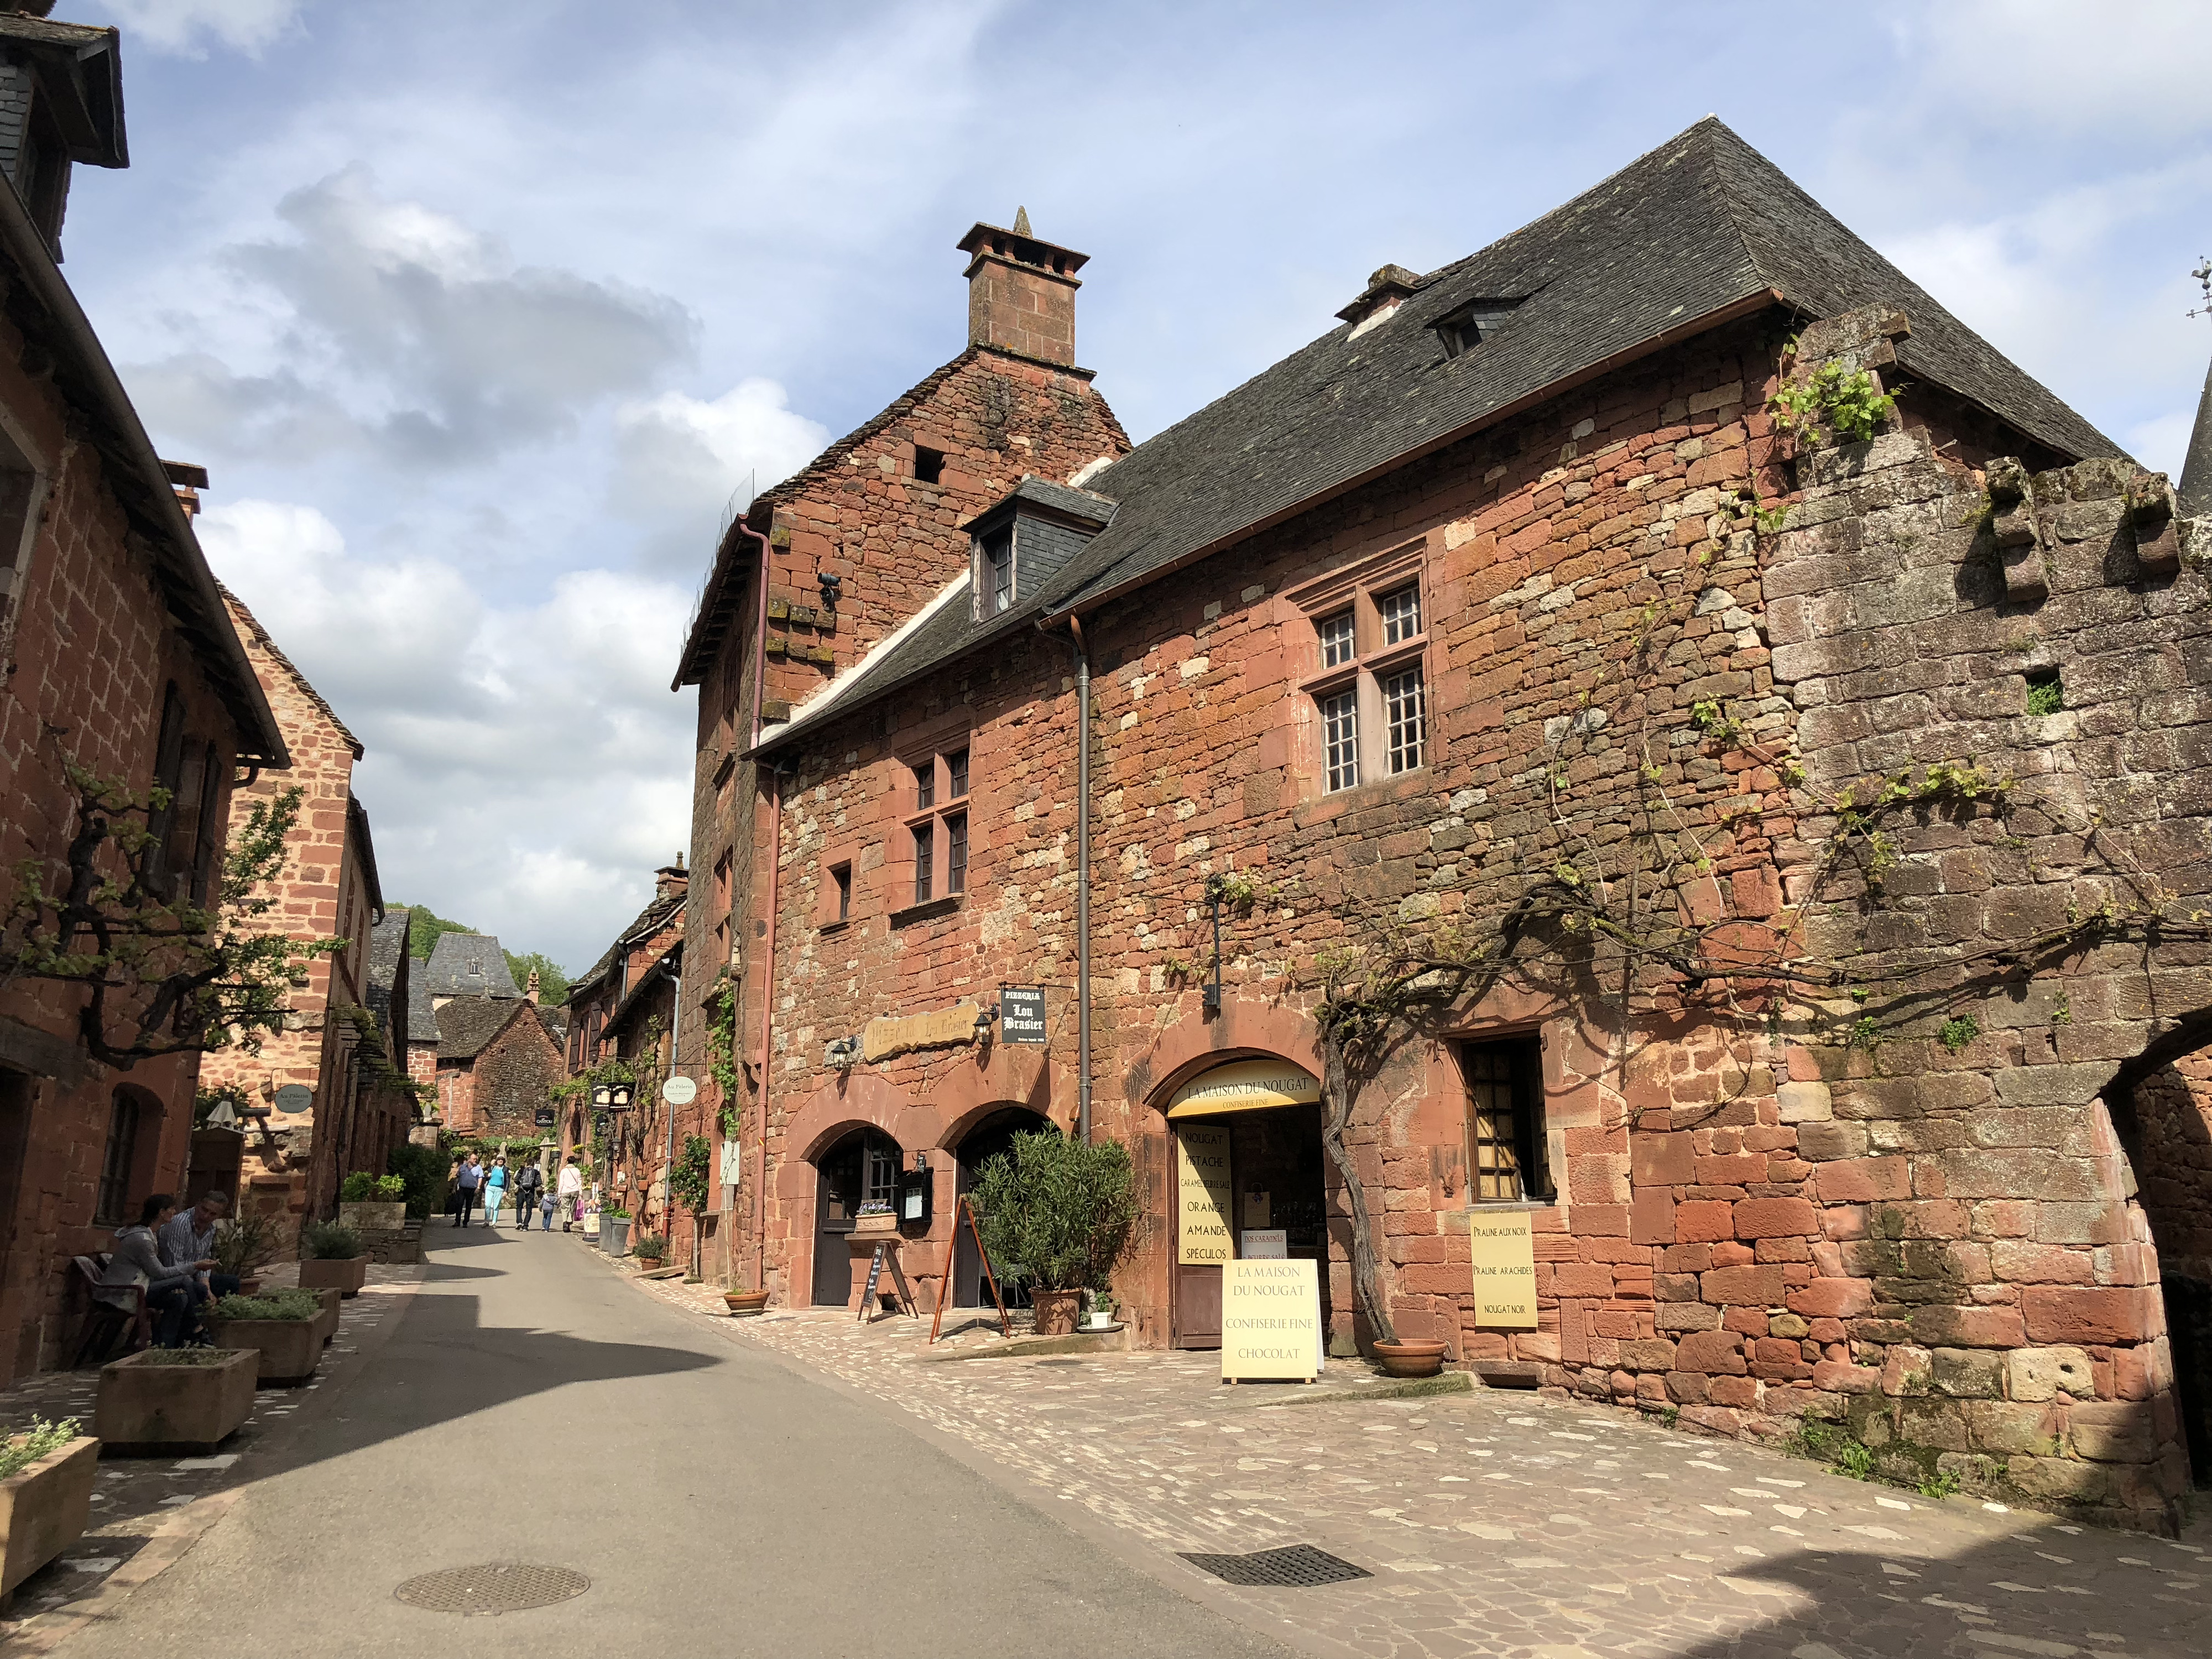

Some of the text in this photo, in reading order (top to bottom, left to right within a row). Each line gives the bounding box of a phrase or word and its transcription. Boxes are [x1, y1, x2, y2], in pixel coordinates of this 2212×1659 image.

[1005, 992, 1041, 1001] PIZZERIA
[1013, 1004, 1033, 1016] Lou
[925, 1022, 938, 1037] Lou
[1004, 1017, 1043, 1031] Brasier
[1188, 1078, 1308, 1099] LA MAISON DU NOUGAT
[1222, 1100, 1254, 1109] CONFISERIE
[1186, 1133, 1223, 1145] NOUGAT
[1186, 1155, 1223, 1167] PISTACHE
[1181, 1178, 1203, 1187] CARAMEL
[1187, 1201, 1224, 1213] ORANGE
[1187, 1225, 1226, 1236] AMANDE
[1499, 1228, 1511, 1237] AUX
[1512, 1227, 1527, 1236] NOIX
[1186, 1247, 1226, 1259] SPÉCULOS
[1238, 1266, 1300, 1277] LA MAISON
[1500, 1266, 1532, 1275] ARACHIDES
[1234, 1285, 1305, 1296] DU NOUGAT
[1484, 1305, 1526, 1314] NOUGAT NOIR
[1225, 1318, 1313, 1328] CONFISERIE FINE
[1238, 1348, 1300, 1359] CHOCOLAT
